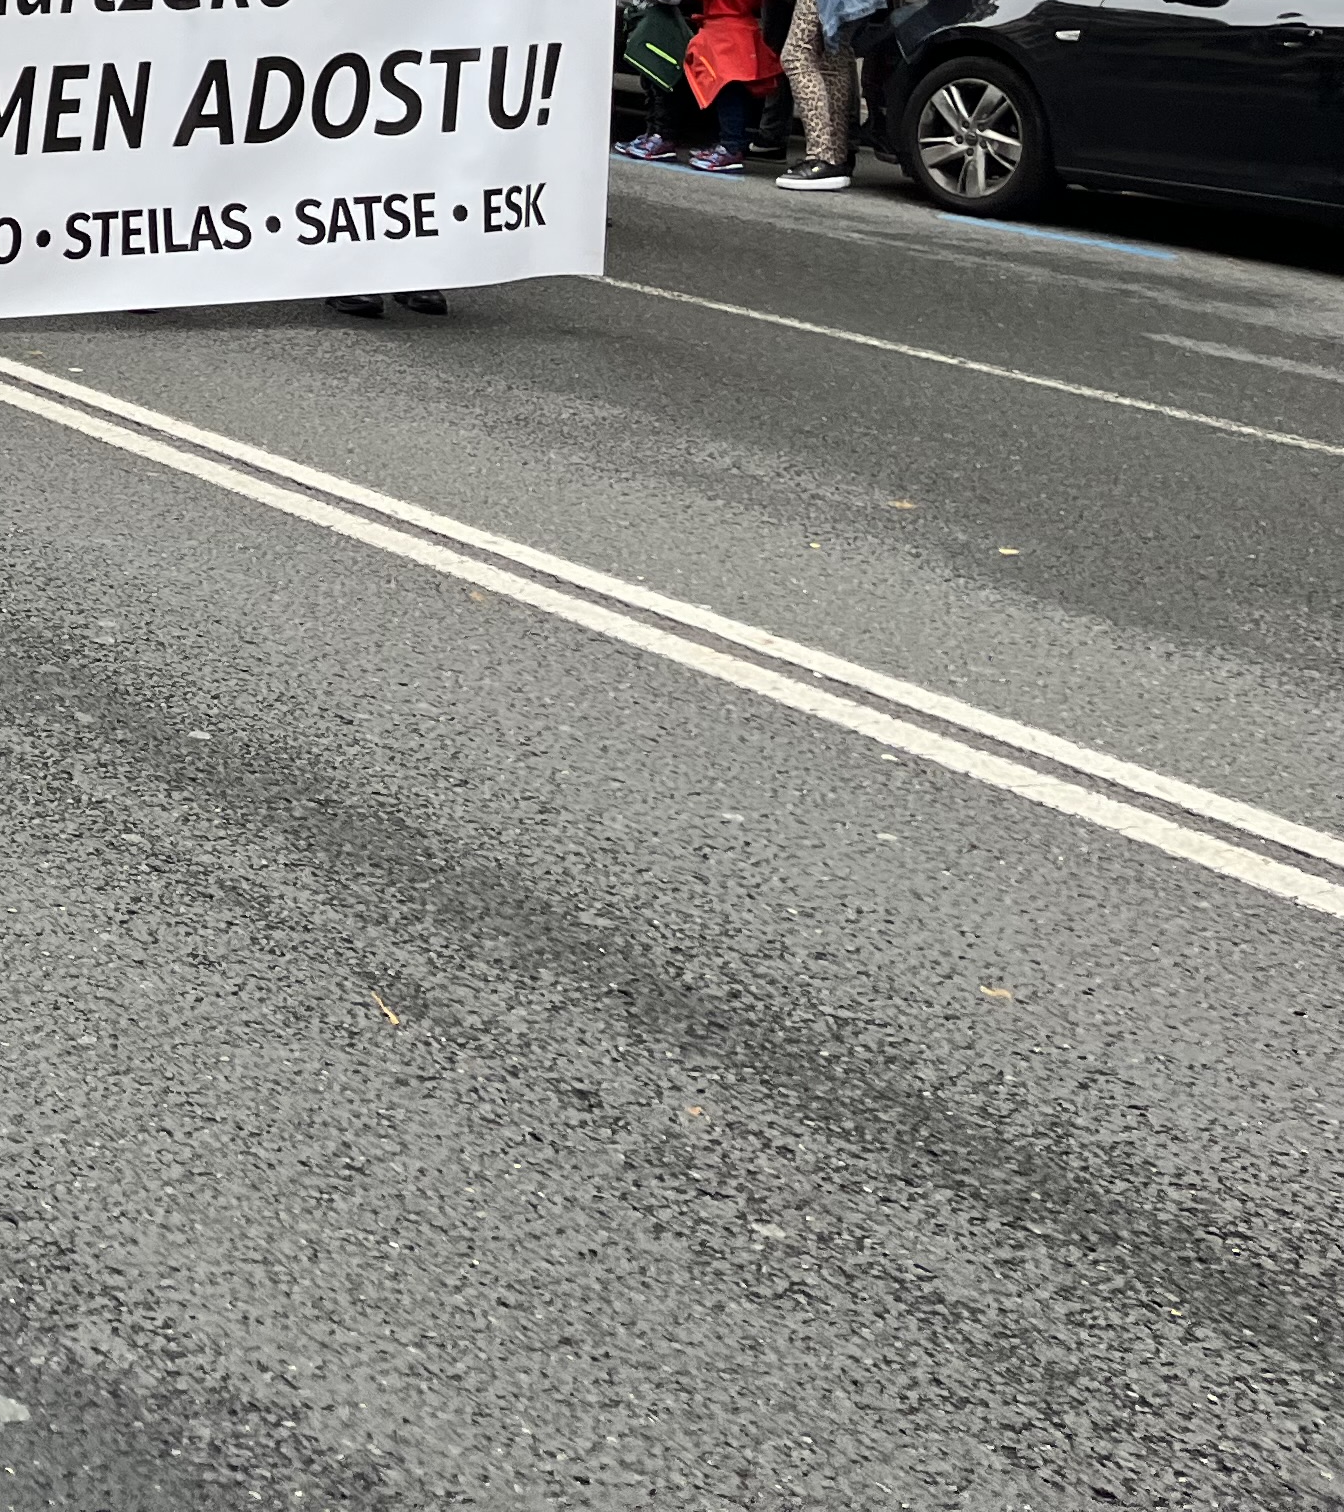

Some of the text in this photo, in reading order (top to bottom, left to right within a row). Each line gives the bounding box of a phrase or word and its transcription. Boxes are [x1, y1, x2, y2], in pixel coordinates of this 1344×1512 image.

[173, 43, 562, 146] ADOSTU!
[63, 203, 251, 259] STEILAS
[296, 193, 438, 245] SATSE
[484, 182, 546, 232] ESK
